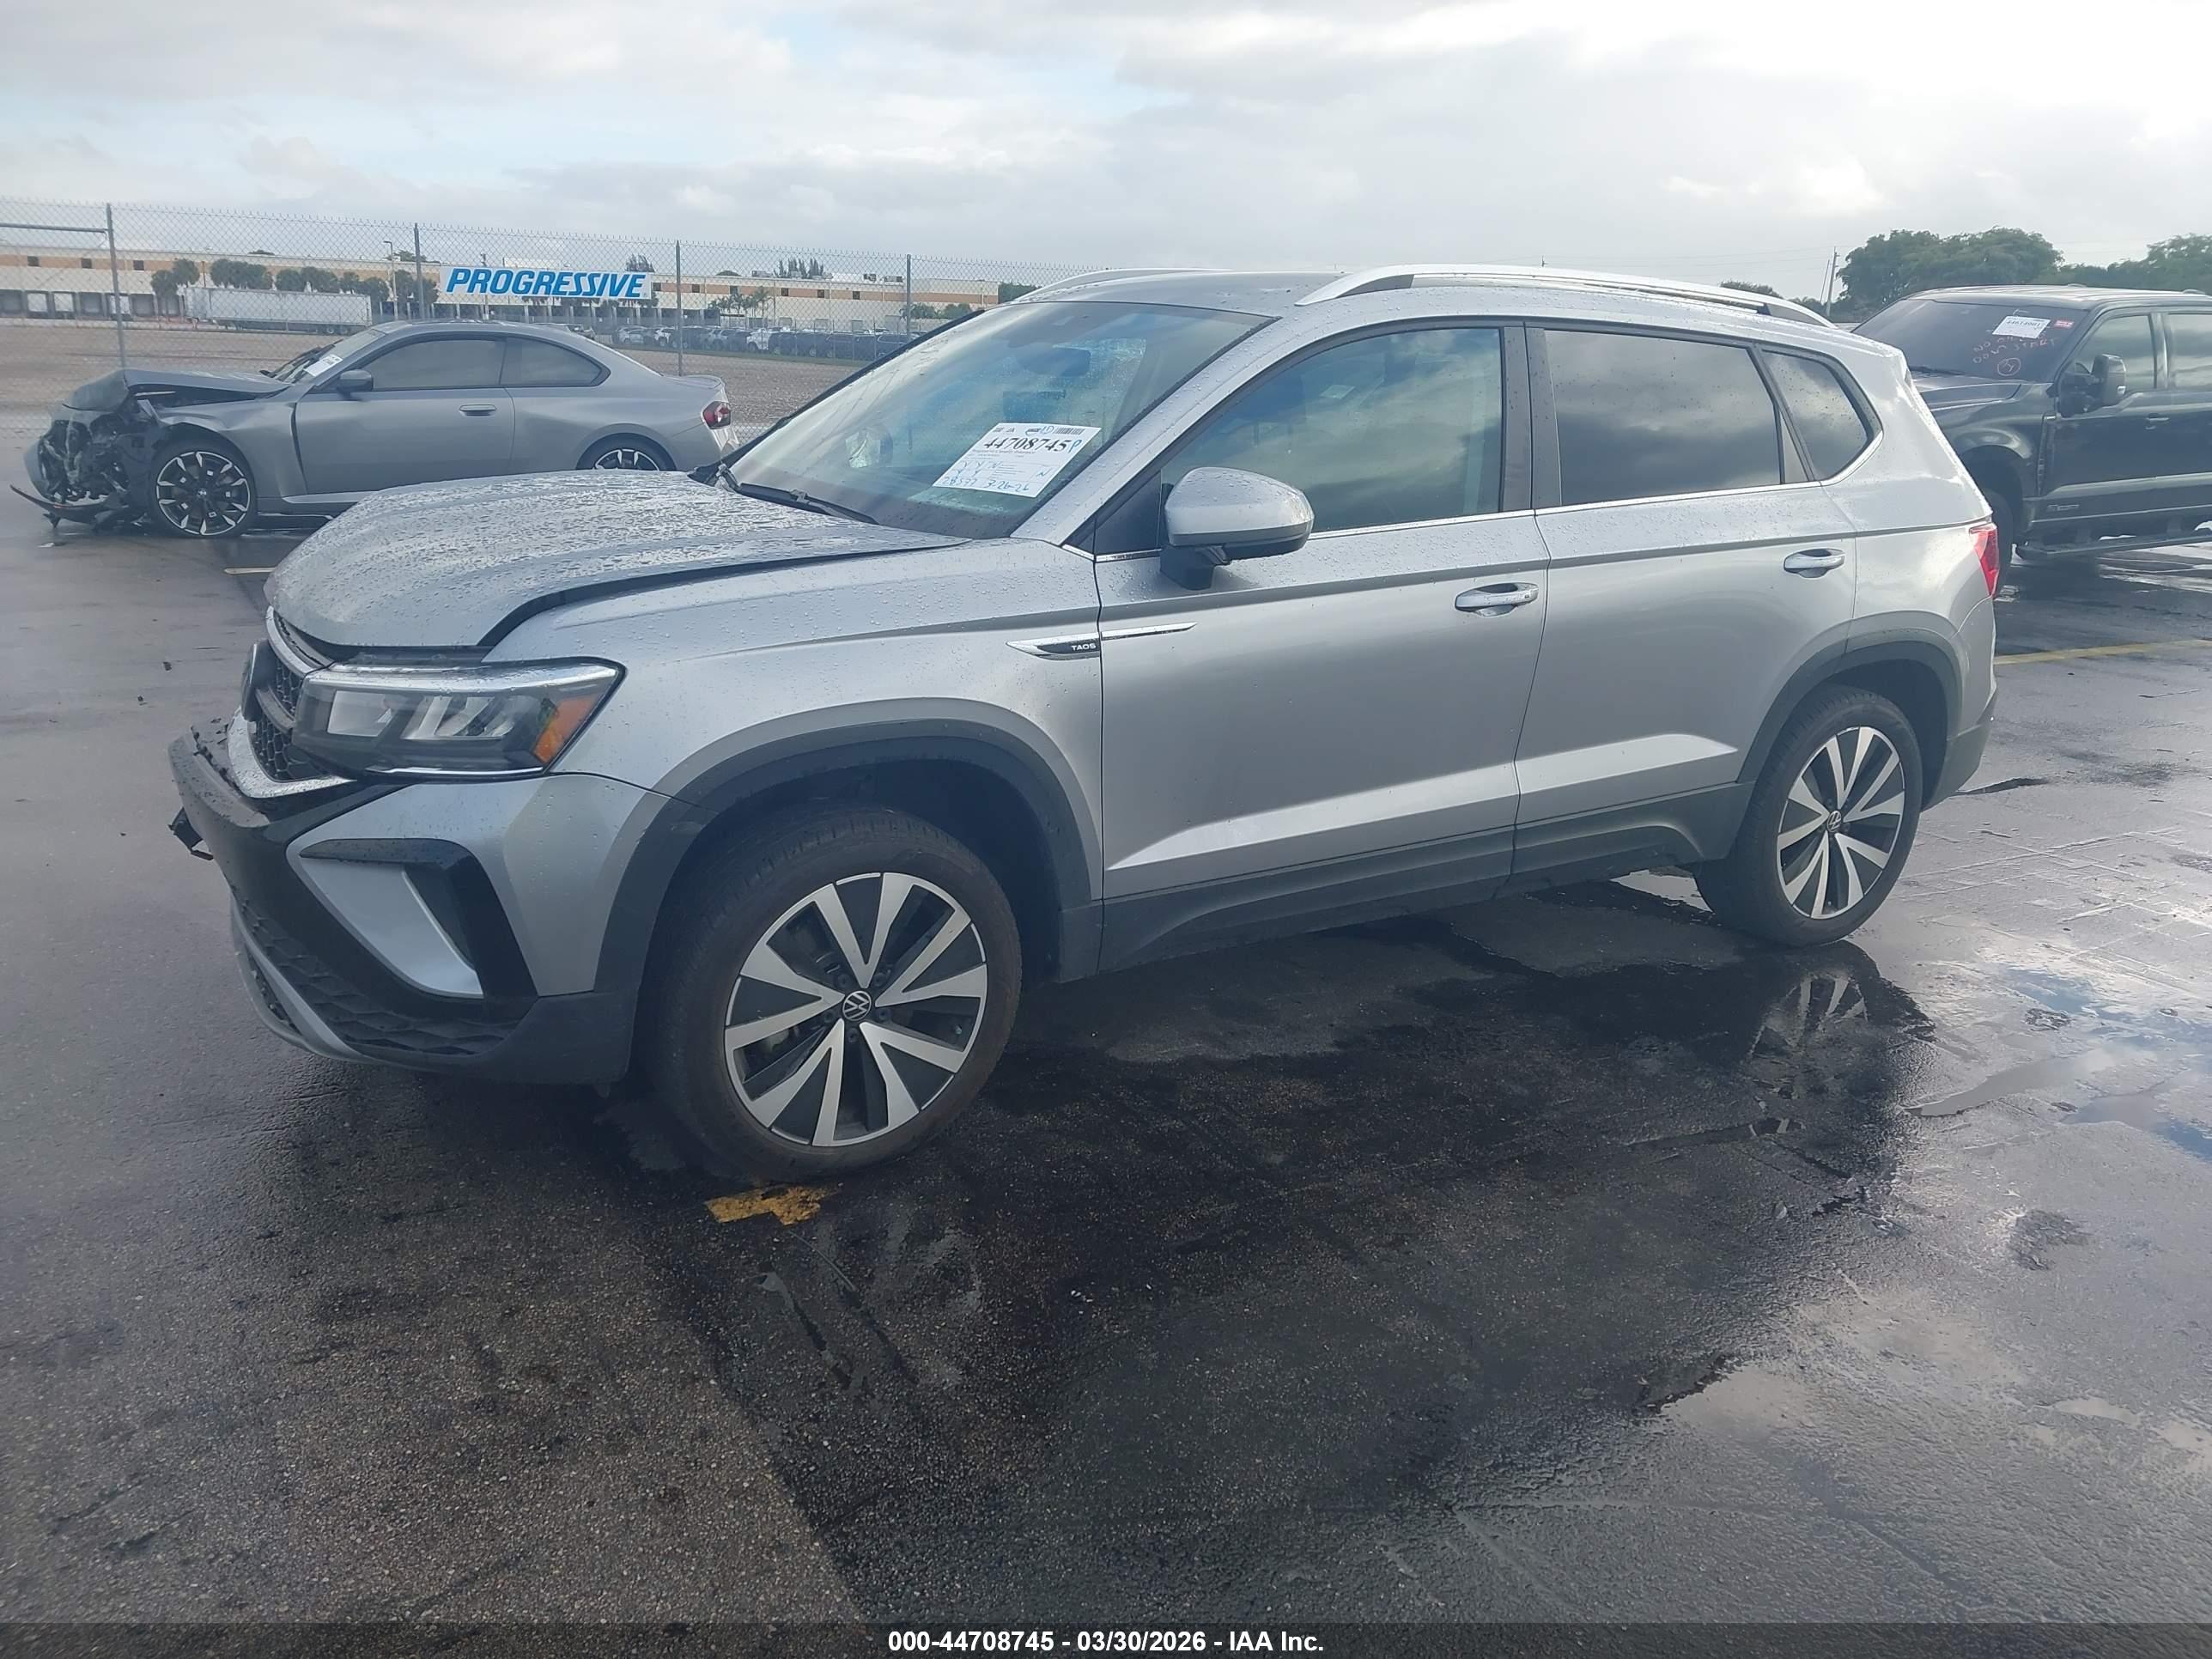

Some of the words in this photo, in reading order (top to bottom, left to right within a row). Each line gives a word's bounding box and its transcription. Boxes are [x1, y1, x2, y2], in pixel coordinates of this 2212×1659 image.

[446, 267, 647, 298] PROGRESSIVE
[984, 437, 1073, 452] 44708745
[1071, 642, 1097, 651] TAOS
